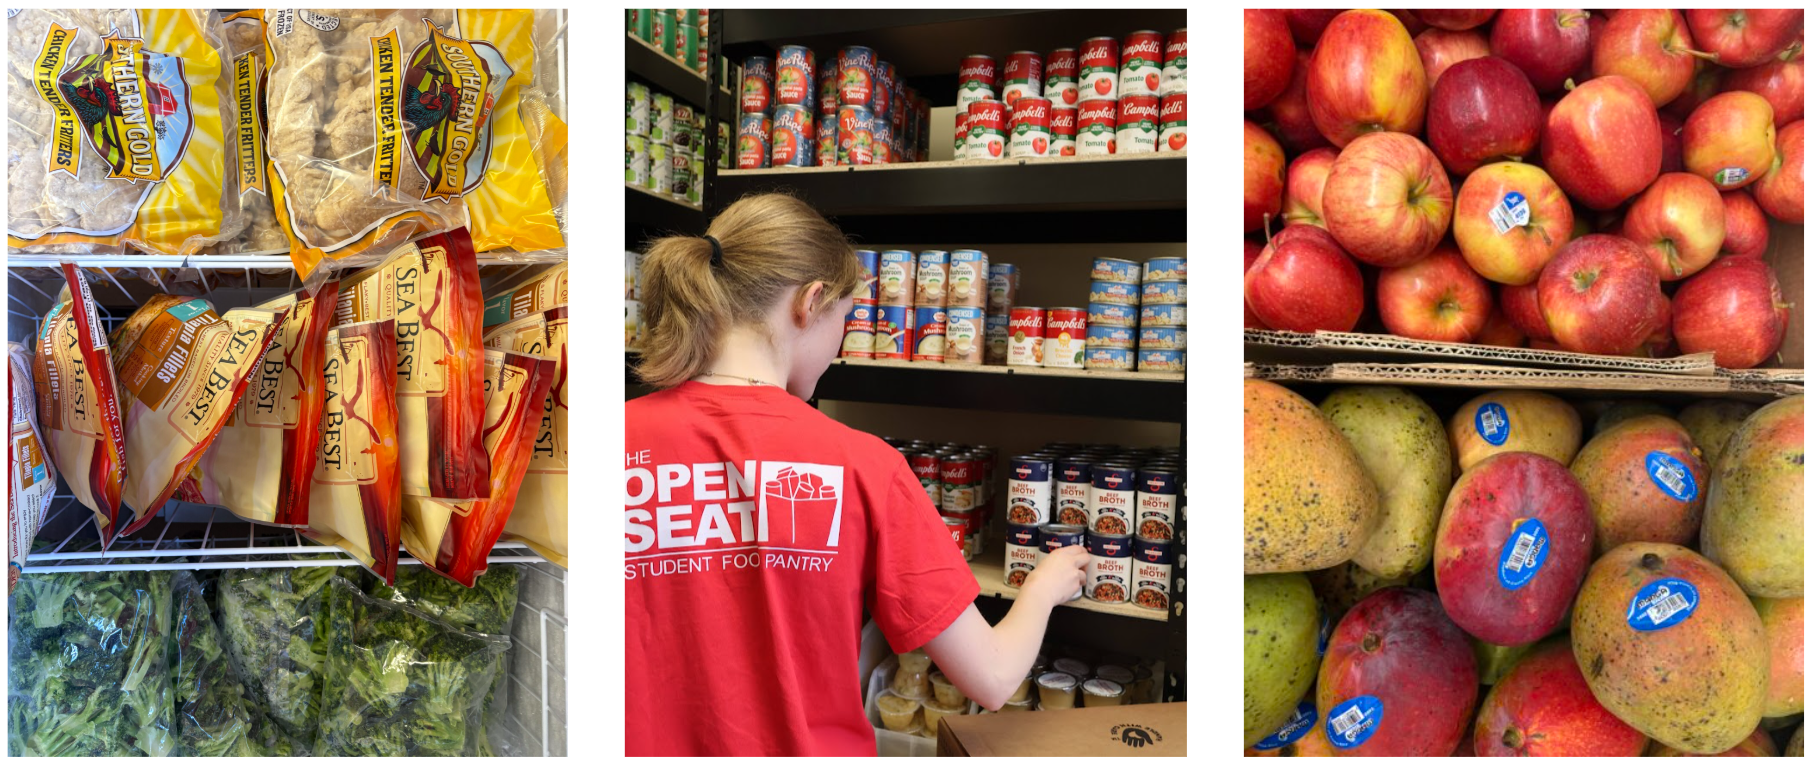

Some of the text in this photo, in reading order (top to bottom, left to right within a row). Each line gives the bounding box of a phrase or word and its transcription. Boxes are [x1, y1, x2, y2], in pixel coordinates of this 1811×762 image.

[276, 10, 285, 36] FROZEN
[791, 53, 812, 73] Ripe
[39, 29, 74, 166] CHICKEN TENDER FRITTERS
[239, 83, 253, 125] TENDER
[744, 99, 761, 107] Sauce
[846, 90, 865, 99] Sauce
[441, 43, 481, 188] SOUTHERN GOLD
[781, 114, 802, 132] Ripe
[379, 76, 396, 197] TENDER FRITTERS
[749, 122, 769, 139] Ripe
[126, 128, 152, 176] GOLD
[241, 127, 256, 184] FRITTERS
[739, 158, 754, 166] Sauce
[335, 286, 357, 326] ilapia
[66, 312, 78, 349] EA
[180, 314, 218, 344] Tilapia
[396, 267, 420, 382] SEA BEST
[1046, 316, 1086, 330] Campbell's
[158, 326, 176, 353] Texture
[218, 329, 257, 366] SEA
[157, 345, 189, 384] Fillets
[200, 361, 212, 382] SINCE
[187, 368, 232, 426] BEST
[190, 384, 202, 400] 1979
[257, 358, 284, 414] BEST
[323, 358, 344, 470] SEA BEST
[113, 424, 121, 442] for
[20, 444, 32, 479] Tilapia Fillets
[626, 450, 652, 466] HE
[625, 460, 756, 506] OPEN
[1012, 486, 1035, 495] BROTH
[1061, 488, 1084, 497] BROTH
[1099, 496, 1126, 504] BROTH
[1142, 500, 1169, 509] BROTH
[625, 500, 756, 553] SEAT
[625, 552, 834, 580] STUDENT FOO PANTRY
[1011, 551, 1035, 560] BROTH
[1097, 563, 1124, 572] BROTH
[1140, 569, 1166, 578] BROTH
